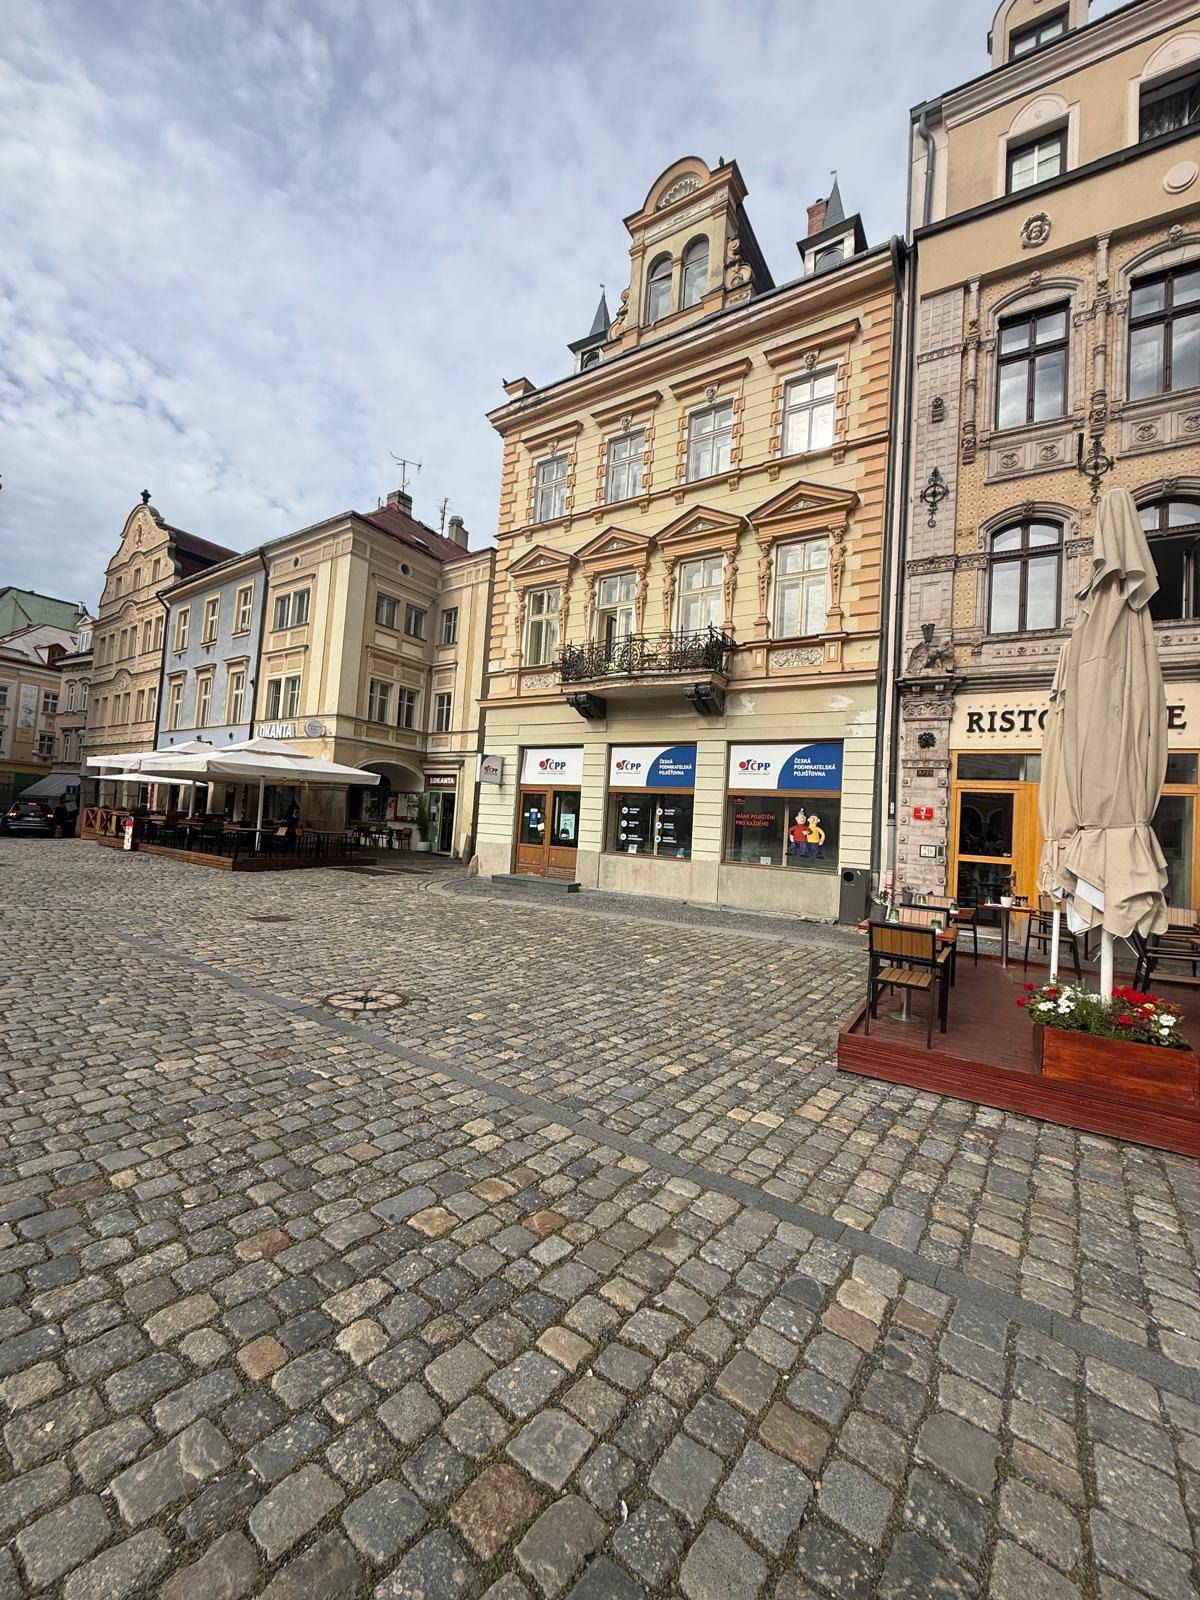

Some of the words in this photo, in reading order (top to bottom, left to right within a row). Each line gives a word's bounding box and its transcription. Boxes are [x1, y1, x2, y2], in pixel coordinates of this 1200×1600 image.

[256, 723, 294, 738] LOKANTA
[549, 759, 566, 770] ČPP
[625, 760, 641, 771] ČPP
[750, 760, 771, 771] ČPP
[920, 807, 926, 815] 3
